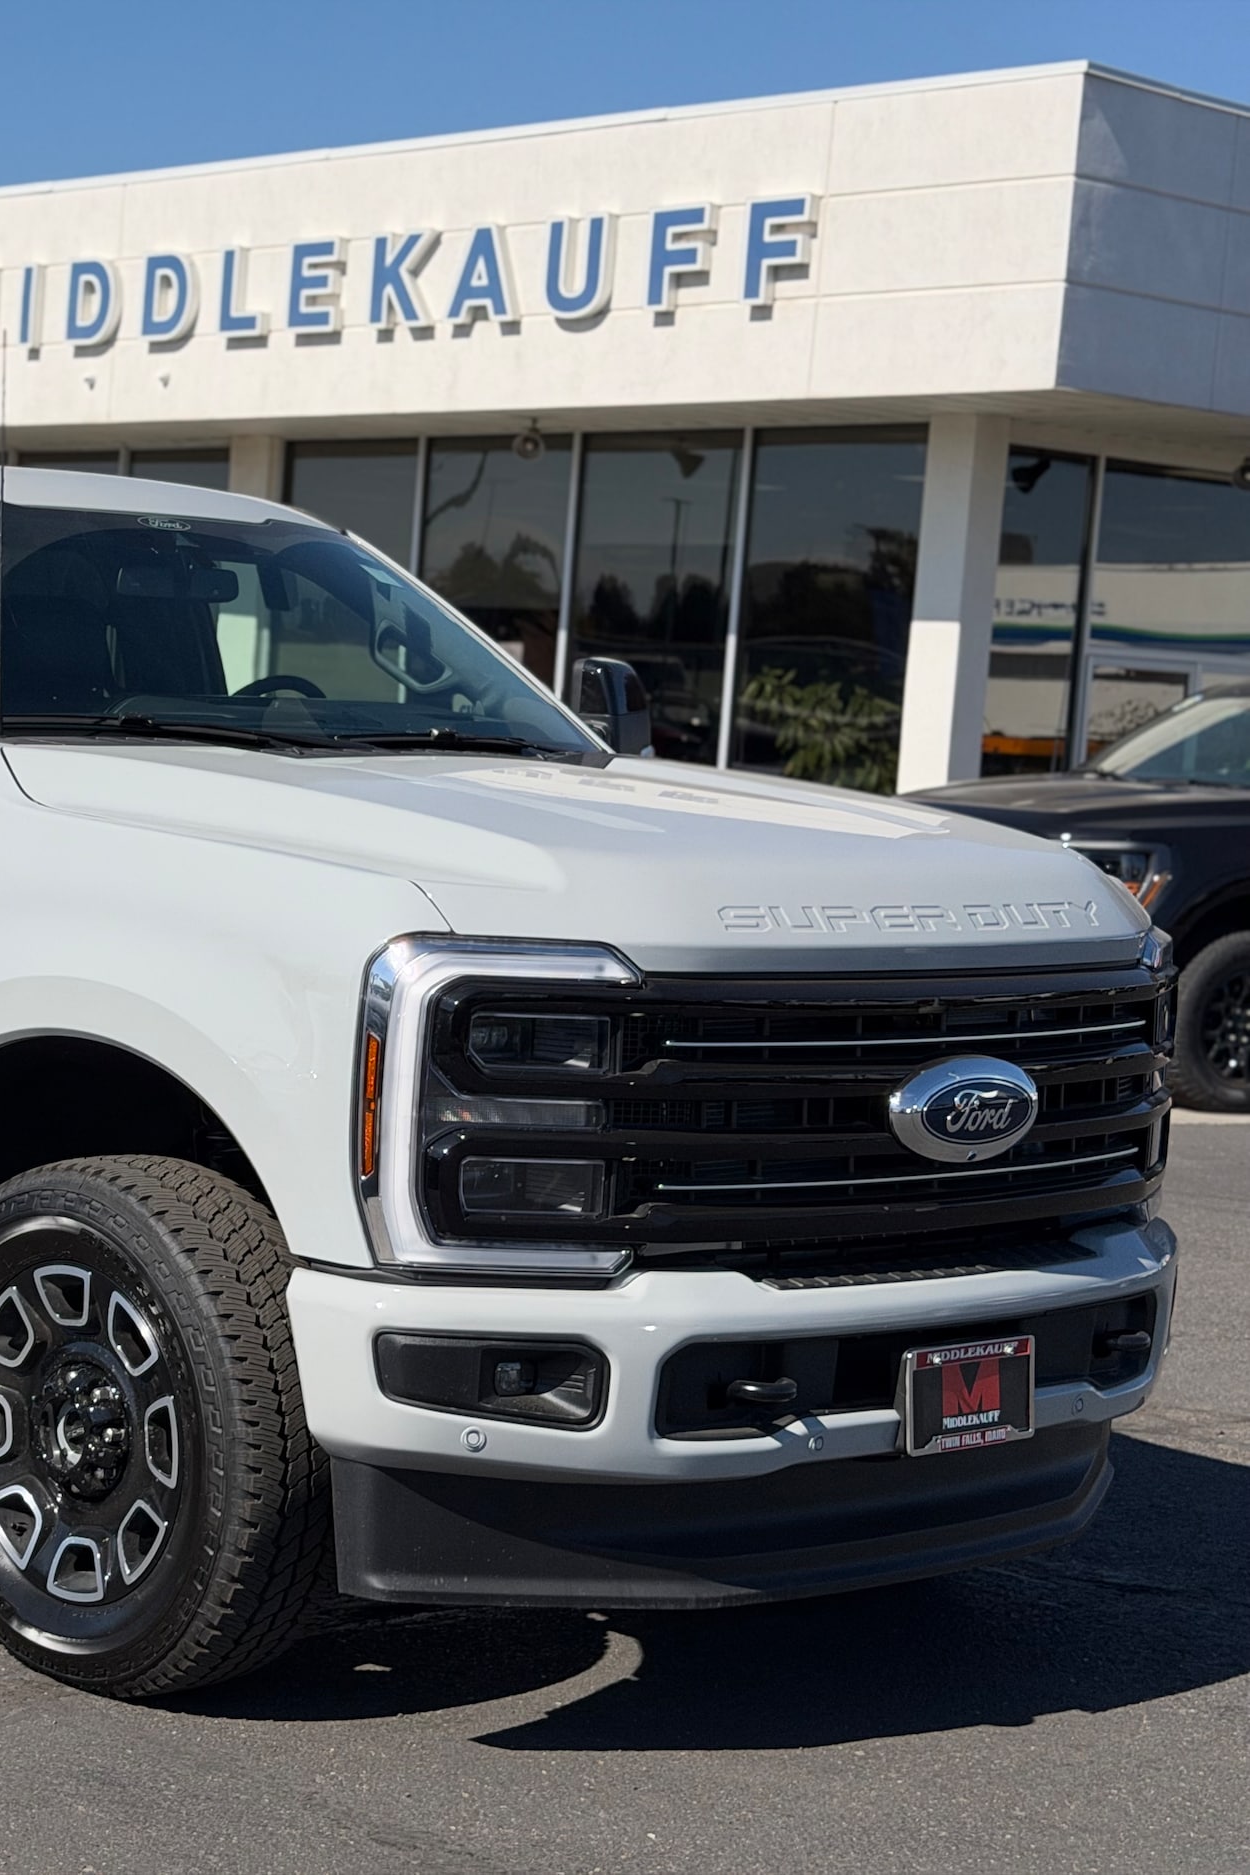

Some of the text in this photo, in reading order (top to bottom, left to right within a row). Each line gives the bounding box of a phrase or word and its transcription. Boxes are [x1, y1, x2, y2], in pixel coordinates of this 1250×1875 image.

[717, 900, 1098, 934] SUPER DUTY
[946, 1089, 1015, 1132] Ford
[941, 1358, 1000, 1417] M
[942, 1409, 1001, 1430] MIDDLEKAUFF
